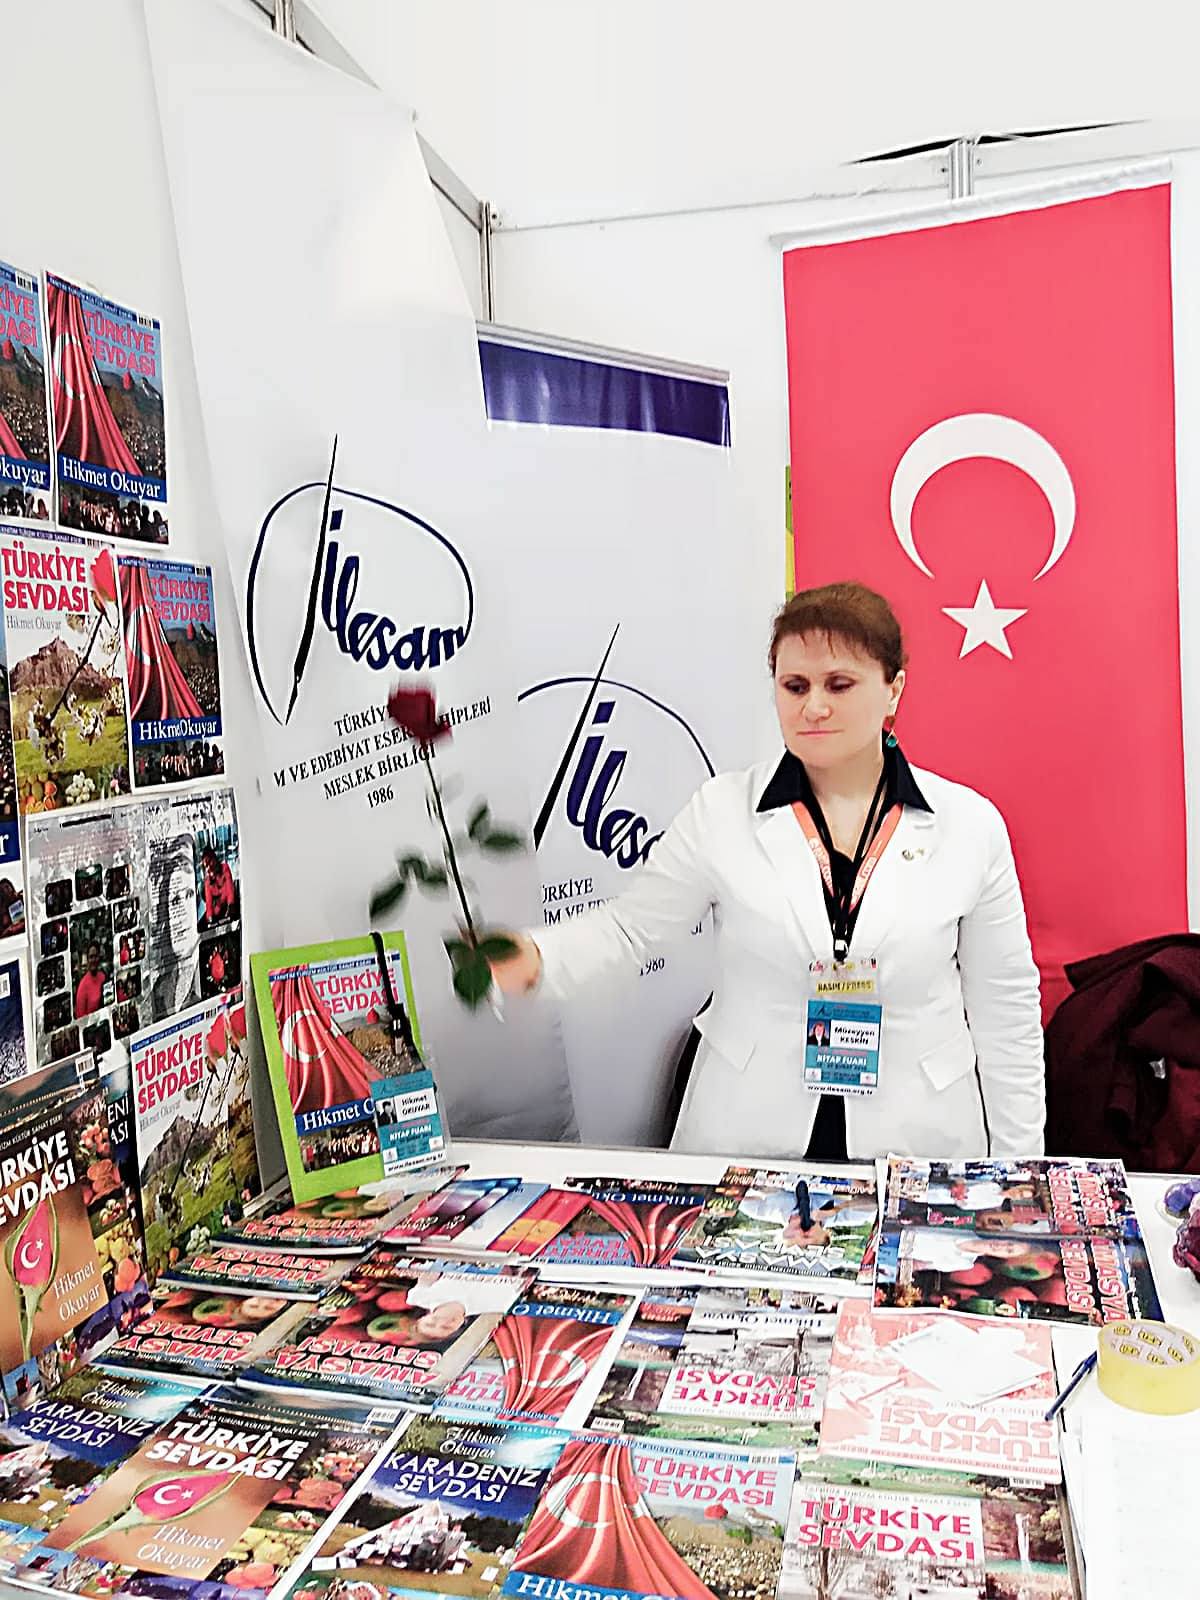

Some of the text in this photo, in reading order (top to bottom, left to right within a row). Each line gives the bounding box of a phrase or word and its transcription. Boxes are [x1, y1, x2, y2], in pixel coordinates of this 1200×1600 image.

[0, 283, 36, 323] İYE
[85, 310, 155, 355] TÜRKİYE
[85, 335, 156, 377] SEVDASI
[0, 458, 47, 487] kuyar
[63, 457, 161, 500] Hikmet Okuyar
[1, 540, 86, 583] TÜRKİYE
[3, 580, 90, 613] SEVDASI
[150, 573, 209, 602] TÜRKİYE
[152, 600, 211, 623] SEVDASI
[334, 704, 389, 737] TÜRKİY
[288, 762, 310, 783] VE
[311, 738, 371, 776] EDEBİYAT
[374, 724, 416, 750] ESER
[438, 696, 492, 727] HİPLERİ
[323, 764, 374, 801] MESLEK
[367, 784, 395, 809] 1986
[135, 1032, 203, 1086] TÜRKİYE
[138, 1057, 204, 1114] SEVDASI
[31, 1120, 49, 1136] SANAT
[303, 1102, 360, 1131] Hikmet
[0, 1130, 69, 1189] RKİYE
[53, 1262, 96, 1299] Hikmet
[59, 1283, 100, 1321] Okuyar
[535, 1305, 612, 1323] Hikmet
[113, 1335, 252, 1363] AMASY
[133, 1320, 257, 1346] SEVDAS
[297, 1336, 442, 1368] SEVDASI
[275, 1352, 442, 1386] AMASYA
[675, 1369, 817, 1391] SEVDASI
[81, 1391, 128, 1410] Okuyar
[95, 1380, 146, 1400] Hikmet
[674, 1386, 815, 1411] TÜRKİYE
[21, 1417, 115, 1448] SEVDASI
[24, 1399, 154, 1437] KARADENİZ
[272, 1425, 298, 1435] SANAT
[880, 1407, 1054, 1438] SEVDASI
[167, 1420, 310, 1460] TÜRKİYE
[439, 1441, 496, 1460] Okuyar
[446, 1426, 507, 1447] Hikmet
[879, 1426, 1058, 1462] TÜRKİYE
[145, 1440, 295, 1481] SEVDASI
[384, 1451, 542, 1488] KARADENİZ
[634, 1455, 778, 1487] TÜRKİYE
[394, 1471, 509, 1503] SEVDASI
[634, 1476, 775, 1506] SEVDASI
[800, 1496, 973, 1535] TÜRKİYE
[153, 1525, 225, 1550] Hikmet
[797, 1524, 976, 1561] SEVDASI
[137, 1543, 210, 1570] Okuyar
